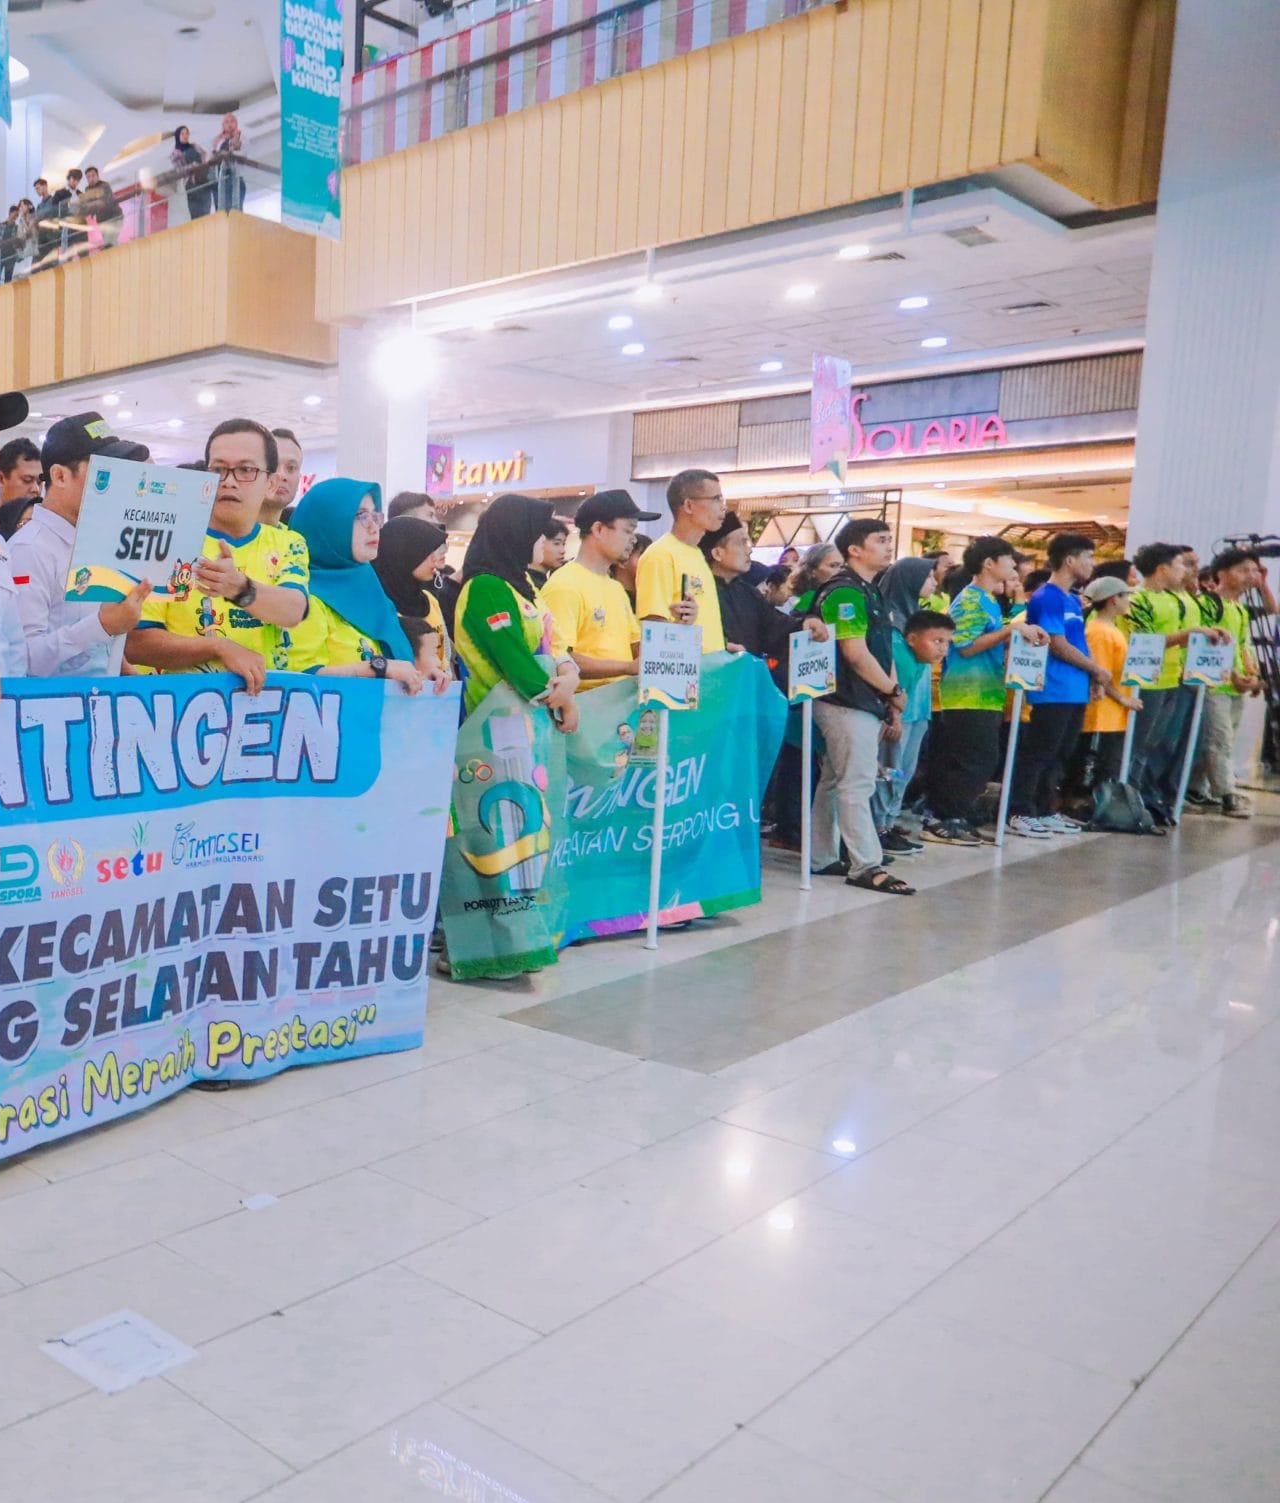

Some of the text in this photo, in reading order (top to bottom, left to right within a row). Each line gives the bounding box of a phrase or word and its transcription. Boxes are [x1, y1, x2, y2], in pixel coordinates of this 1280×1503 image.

[848, 393, 1009, 459] SOLARIA
[123, 508, 176, 525] KECAMATAN
[115, 526, 173, 561] SETU
[644, 661, 697, 676] SERPONG UTARA
[798, 656, 828, 677] SERPONG
[96, 849, 163, 883] setu
[313, 872, 432, 928] SETU
[60, 947, 279, 1047] SELATAN
[293, 933, 428, 990] TAHU
[82, 1028, 196, 1115] Meraih
